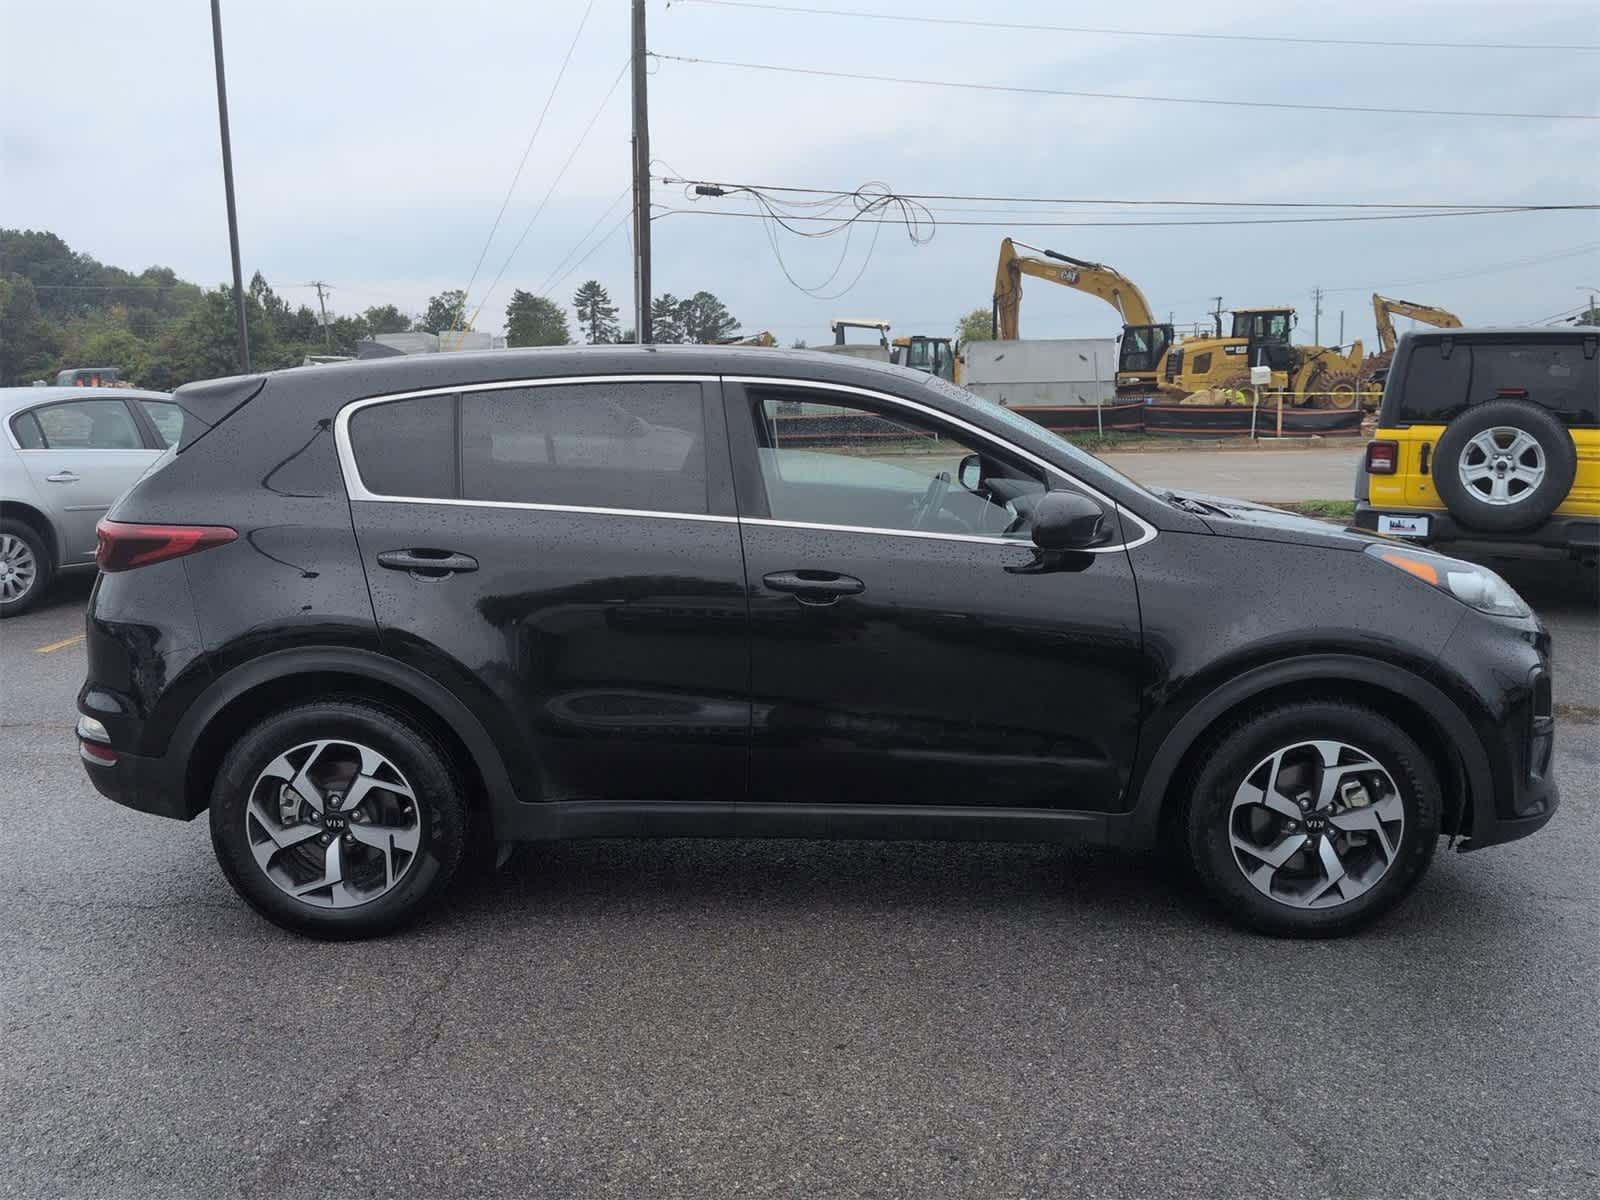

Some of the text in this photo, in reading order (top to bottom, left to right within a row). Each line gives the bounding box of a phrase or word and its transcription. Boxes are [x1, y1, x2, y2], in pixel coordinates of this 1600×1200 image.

[1060, 270, 1078, 282] CAT
[326, 819, 344, 828] KIA
[1306, 820, 1325, 828] KIA
